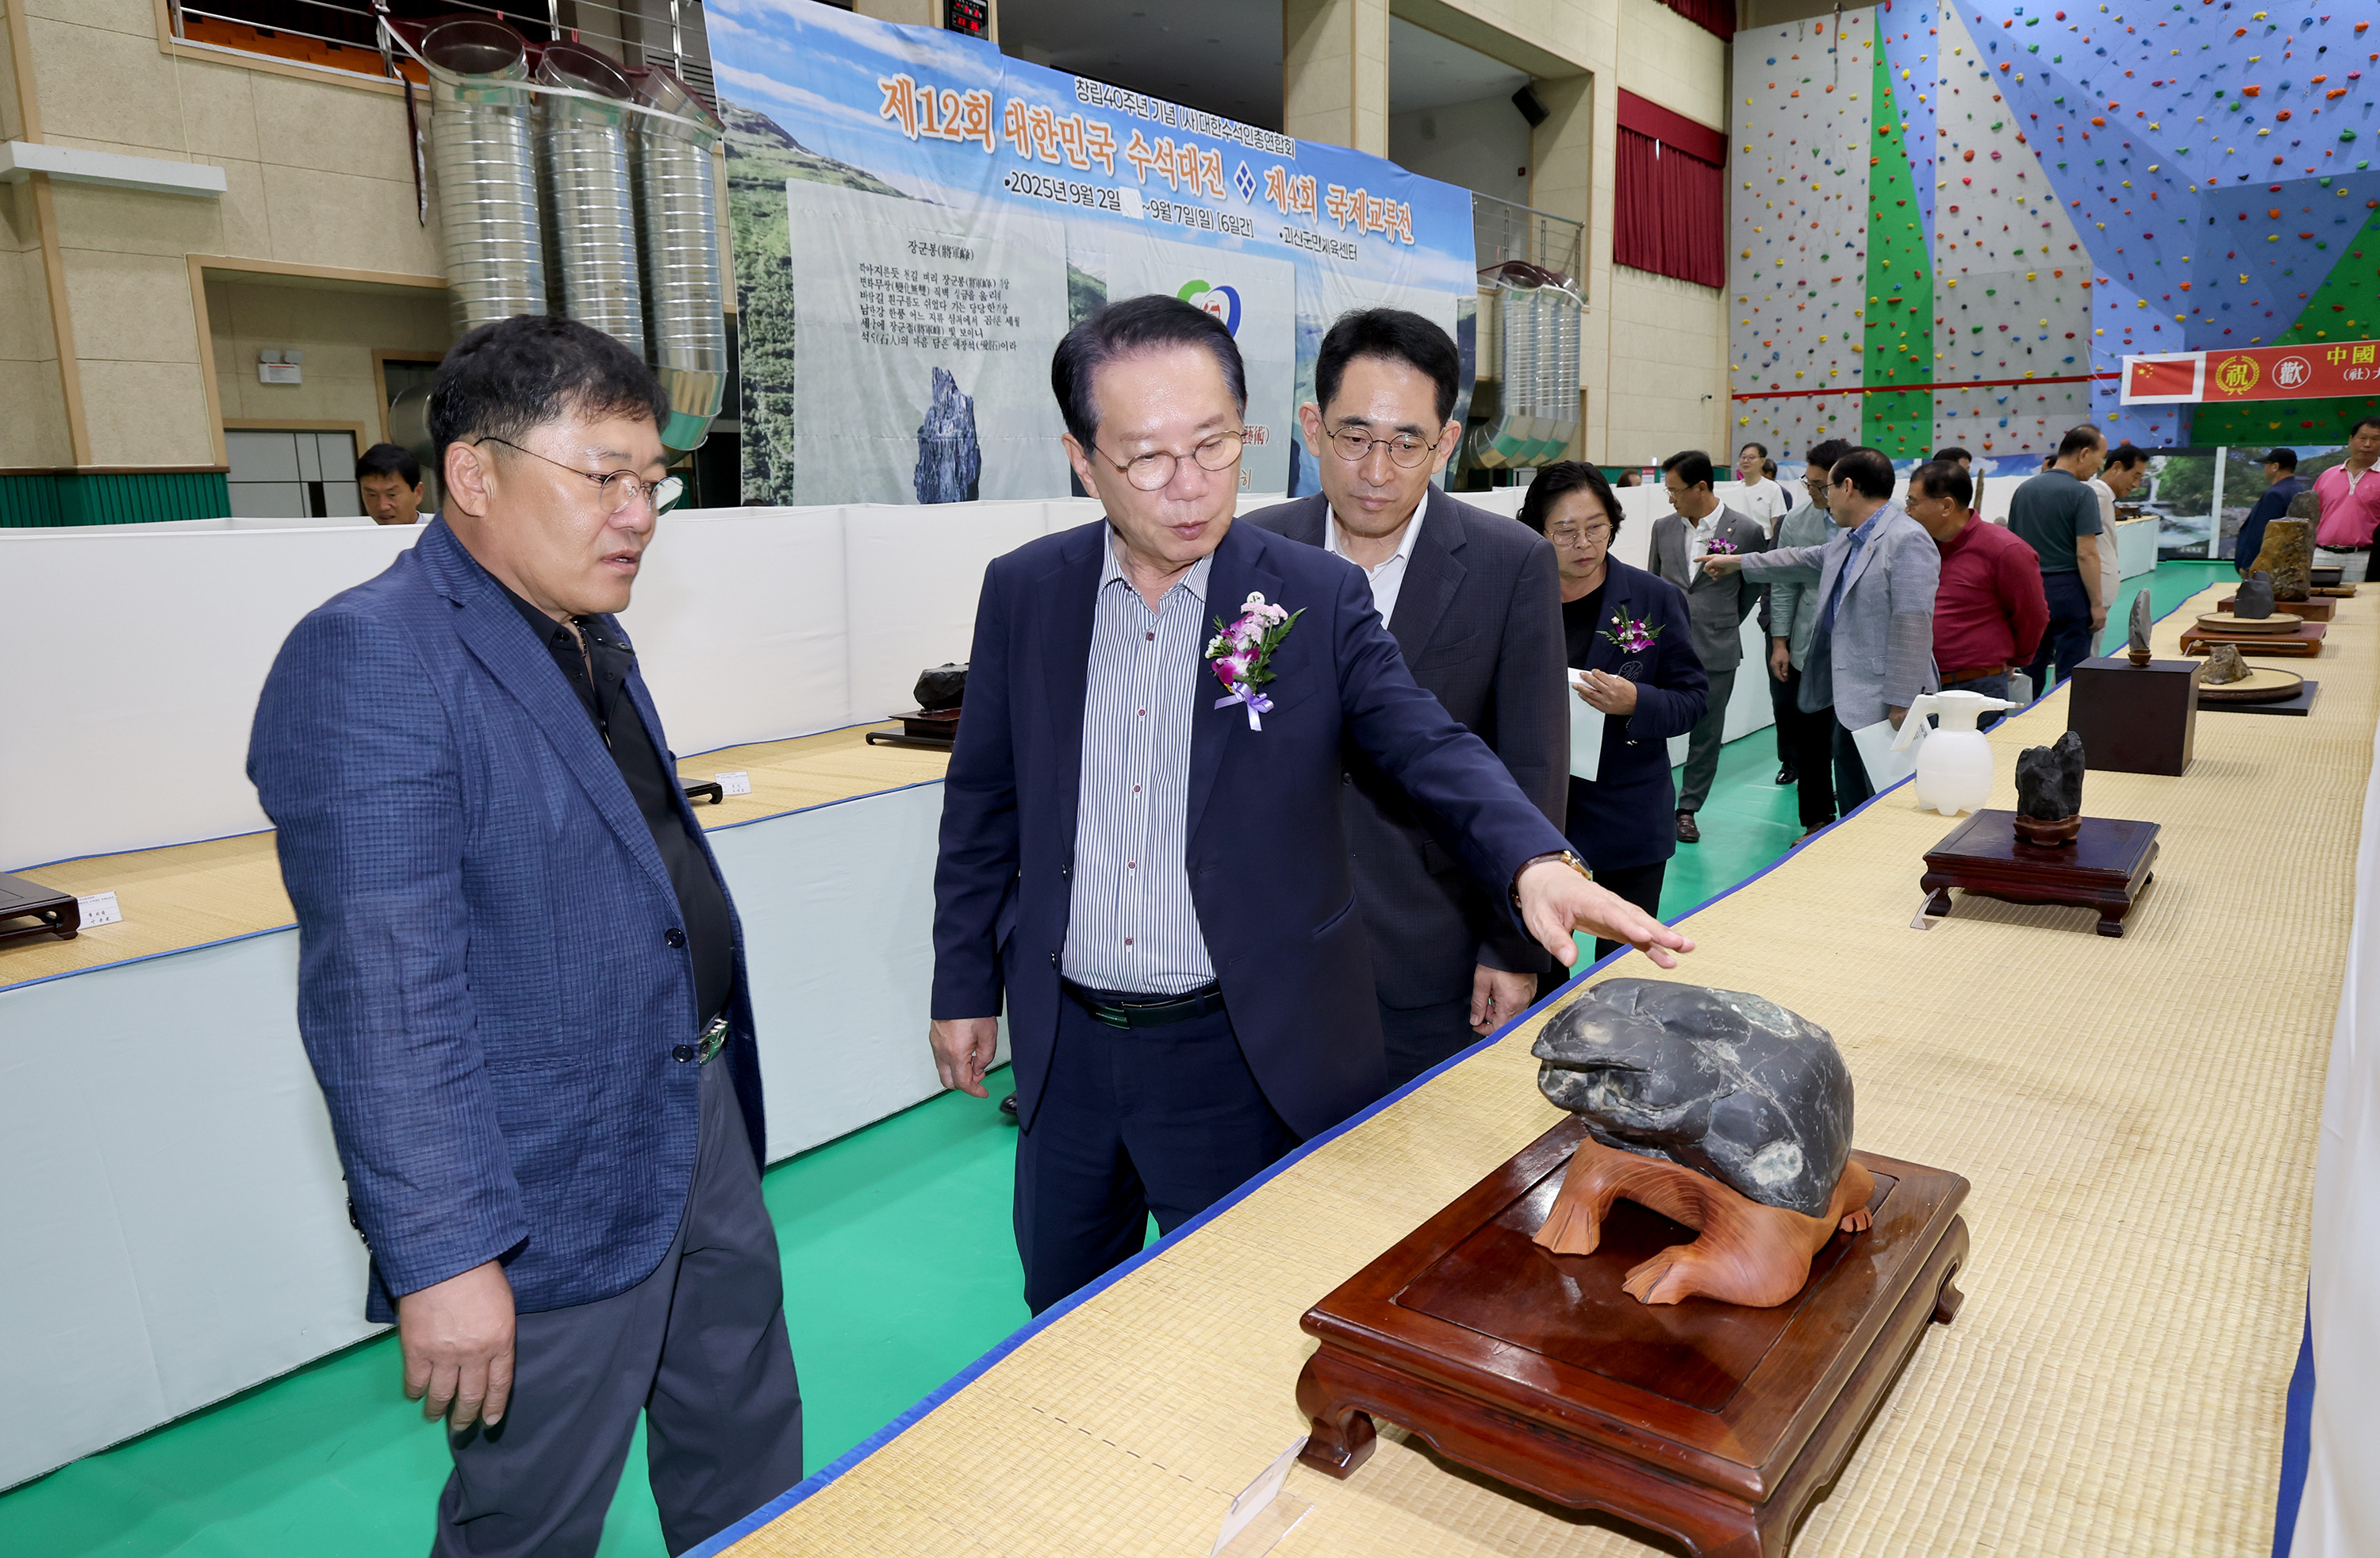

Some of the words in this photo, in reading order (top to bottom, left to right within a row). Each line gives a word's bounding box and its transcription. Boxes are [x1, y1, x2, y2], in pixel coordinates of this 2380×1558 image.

[958, 17, 966, 27] 11
[1076, 79, 1149, 119] 창립40주년
[1153, 101, 1177, 125] 기념
[880, 76, 993, 151] 제12회
[1004, 100, 1115, 174] 대한민국
[1127, 131, 1226, 198] 수석대전
[1012, 171, 1066, 202] 2025년
[1070, 184, 1095, 207] 9월
[1174, 205, 1215, 231] 7일(일)
[1265, 167, 1317, 222] 제4회
[1326, 186, 1414, 243] 국제교류전
[910, 309, 925, 321] 어느
[952, 301, 966, 313] 가는
[960, 327, 984, 339] 보이니
[2327, 344, 2376, 366] 中國
[2225, 364, 2248, 386] 祝
[2279, 361, 2304, 385] 歡
